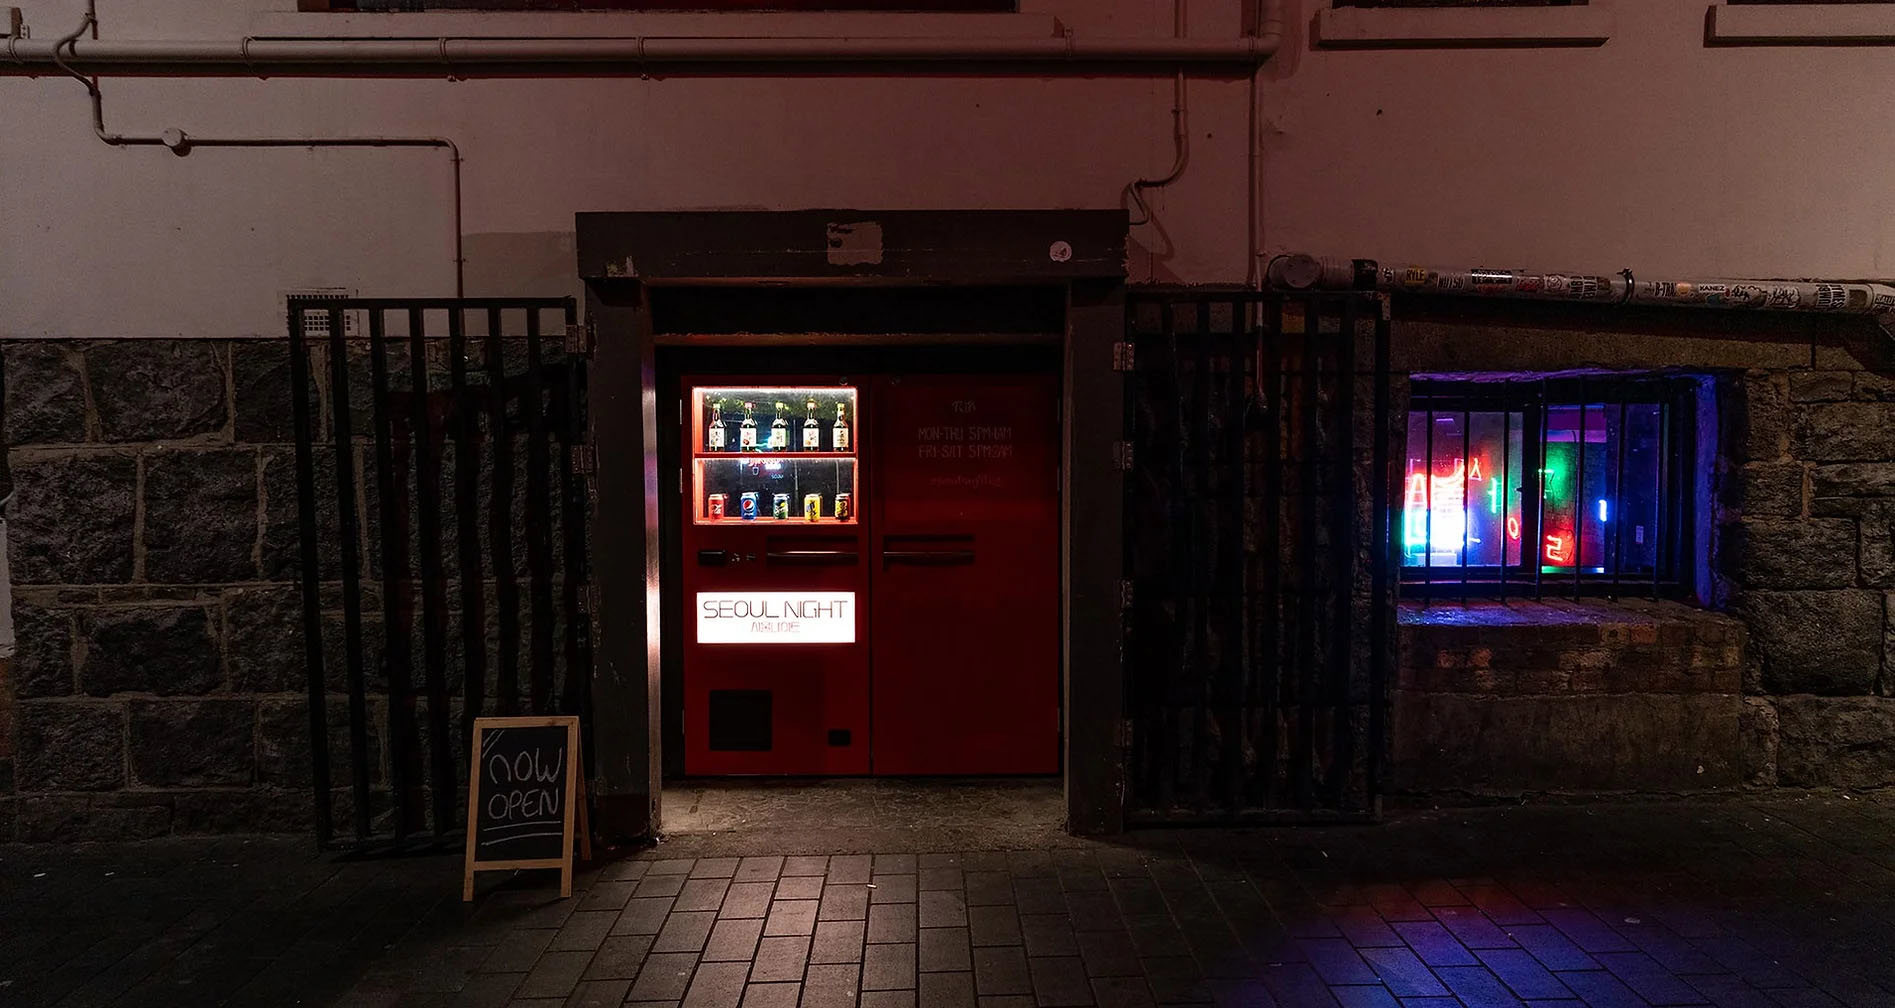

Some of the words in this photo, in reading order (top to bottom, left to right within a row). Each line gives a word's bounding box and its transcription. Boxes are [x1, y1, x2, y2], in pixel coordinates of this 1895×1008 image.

[703, 600, 780, 619] SEOUL
[784, 600, 848, 619] NIGHT
[488, 787, 560, 821] OPEN
